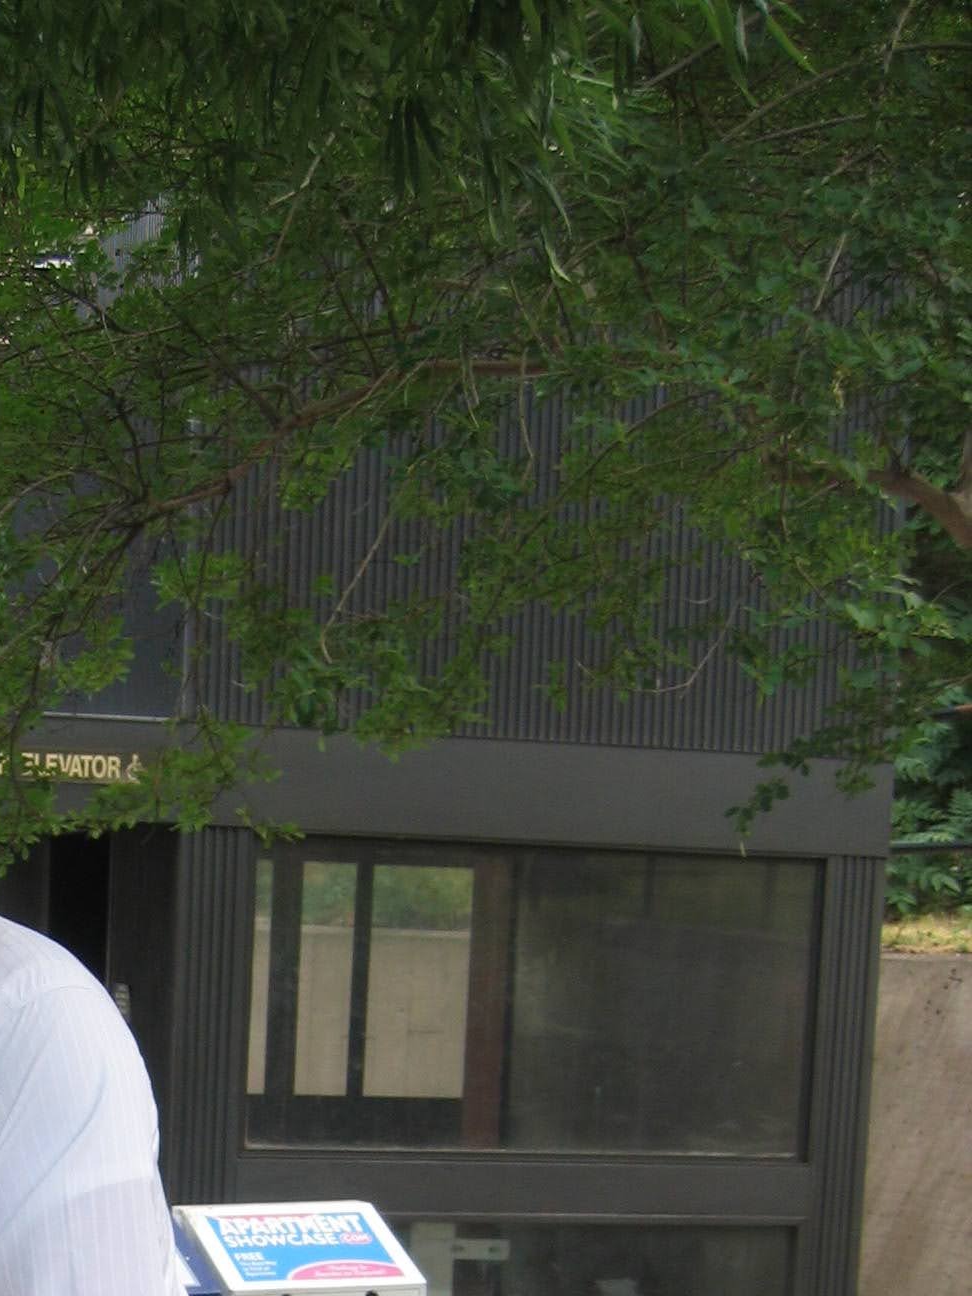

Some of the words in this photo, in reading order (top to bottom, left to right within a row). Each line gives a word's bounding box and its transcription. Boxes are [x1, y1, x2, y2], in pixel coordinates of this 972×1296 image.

[21, 752, 121, 779] ELEVATOR
[218, 1214, 365, 1236] APARTMENT
[234, 1252, 265, 1261] FREE
